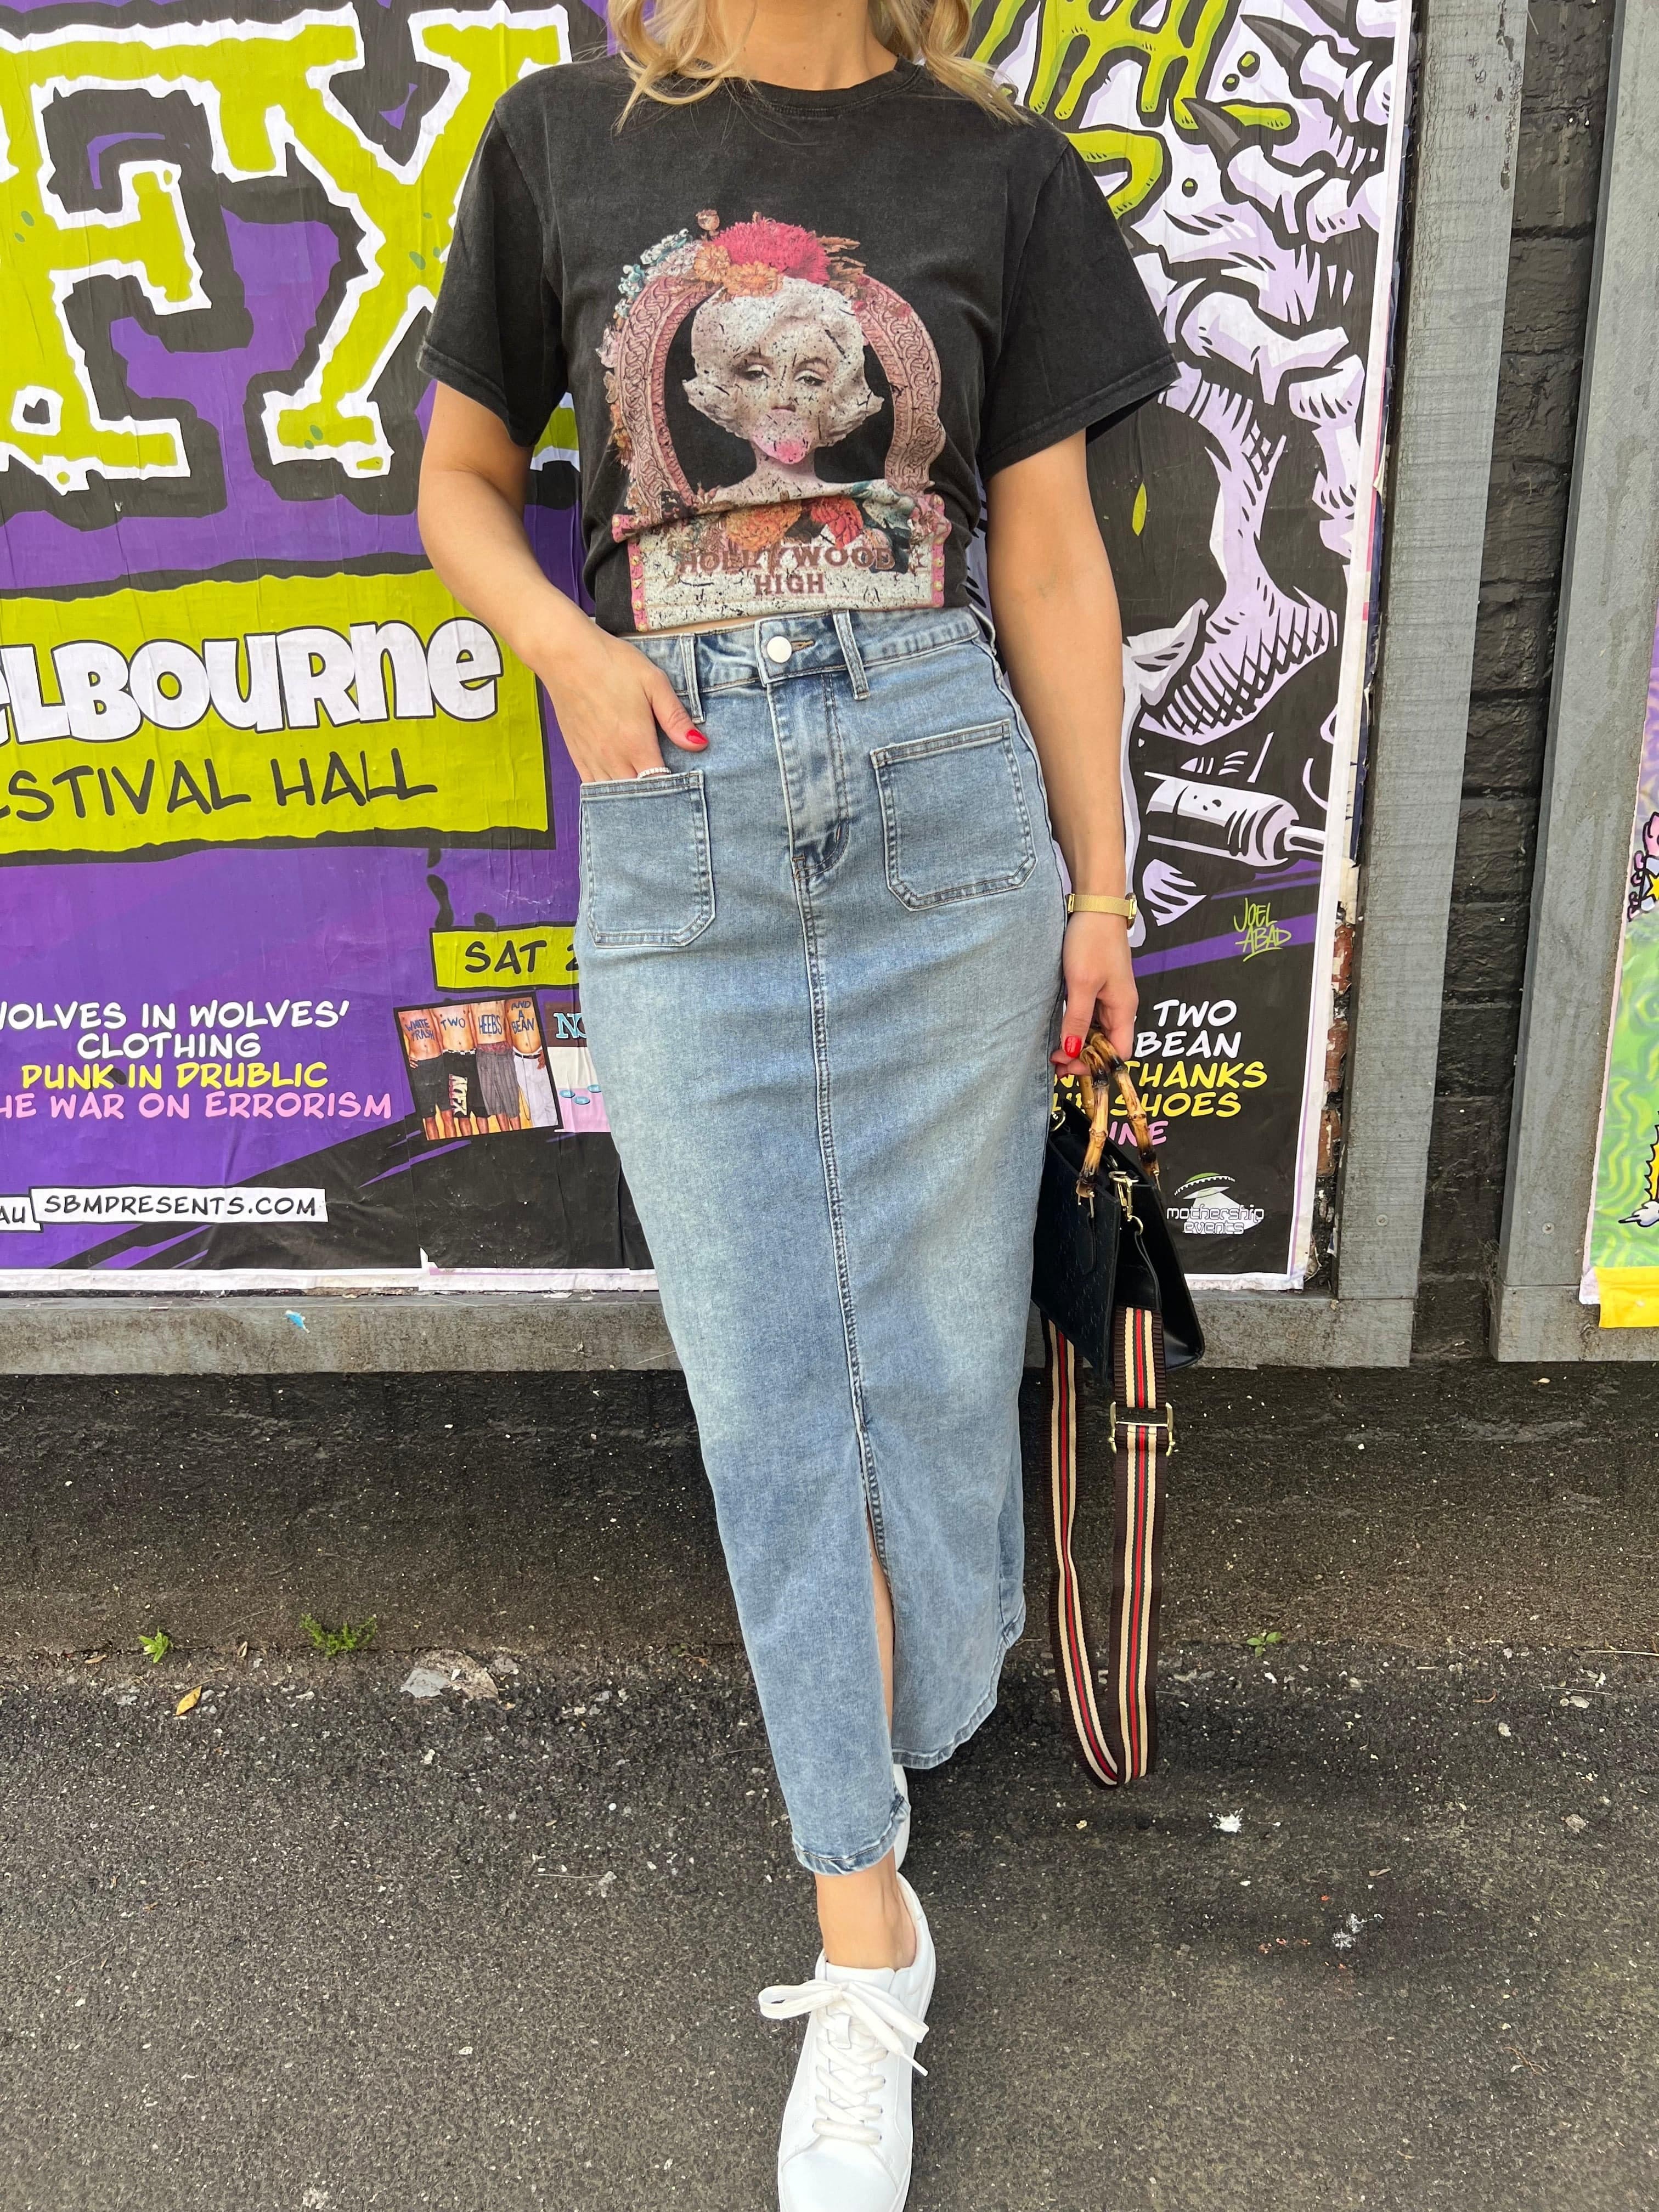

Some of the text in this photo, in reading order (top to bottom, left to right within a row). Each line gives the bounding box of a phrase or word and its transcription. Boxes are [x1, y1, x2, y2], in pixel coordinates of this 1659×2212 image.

[755, 573, 824, 596] HIGH
[0, 748, 438, 821] STIVAL HALL
[1233, 898, 1278, 932] JOEL
[1235, 924, 1291, 953] ABAD
[465, 940, 547, 974] SAT
[142, 1003, 176, 1030] IN
[190, 999, 350, 1029] WOLVES'
[511, 1001, 531, 1011] AND
[518, 1010, 525, 1020] A
[1153, 999, 1238, 1028] TWO
[405, 1018, 430, 1031] WHITE
[411, 1030, 435, 1041] TRASH
[440, 1017, 466, 1031] TWO
[478, 1014, 503, 1035] HEEBS
[512, 1018, 534, 1034] BEAN
[77, 1032, 261, 1059] CLOTHING
[1134, 1030, 1242, 1059] BEAN
[22, 1062, 329, 1090] PUNK IN DRUBLIC
[1124, 1060, 1268, 1090] THANKS
[50, 1091, 125, 1120] WAR
[138, 1092, 190, 1119] ON
[205, 1091, 392, 1120] ERRORISM
[449, 1074, 468, 1116] NOFX
[1110, 1091, 1242, 1118] SHOES
[44, 1194, 316, 1216] SBMPRESENTS.COM
[1166, 1203, 1265, 1224] mothership
[1183, 1220, 1245, 1235] events
